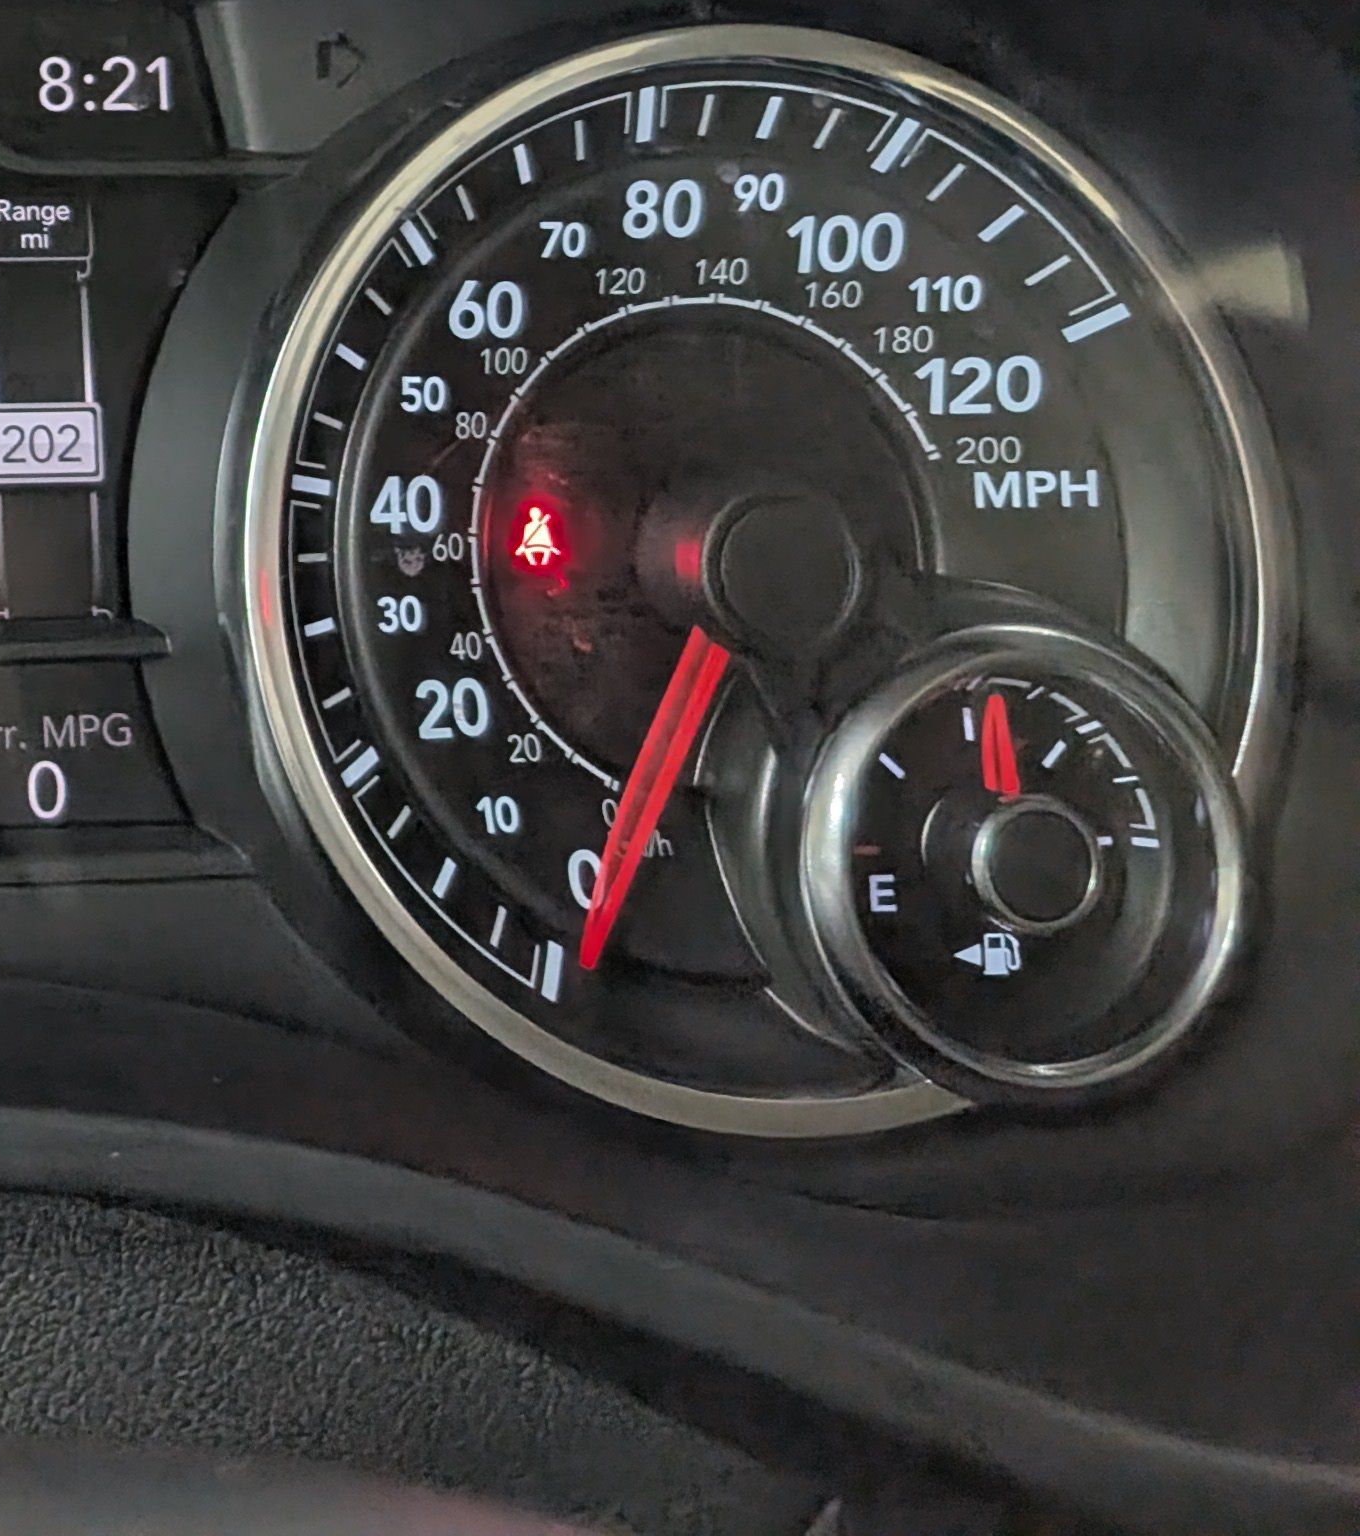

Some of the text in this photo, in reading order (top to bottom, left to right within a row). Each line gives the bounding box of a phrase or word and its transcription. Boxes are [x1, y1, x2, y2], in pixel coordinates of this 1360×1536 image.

[39, 55, 169, 112] 8:21
[622, 178, 703, 239] 80
[733, 172, 785, 212] 90
[20, 226, 50, 249] mi
[539, 221, 587, 259] 70
[786, 212, 905, 274] 100
[595, 267, 646, 295] 120
[695, 257, 749, 286] 140
[448, 279, 524, 340] 60
[805, 280, 863, 309] 160
[908, 274, 983, 313] 110
[873, 325, 934, 354] 180
[480, 346, 528, 375] 100
[400, 375, 447, 413] 50
[913, 355, 1043, 418] 120
[2, 423, 83, 464] 202
[455, 411, 488, 440] 80
[956, 435, 1022, 465] 200
[369, 474, 442, 535] 40
[973, 469, 1099, 509] MPH
[432, 532, 464, 562] 60
[377, 595, 423, 633] 30
[449, 631, 482, 661] 40
[415, 677, 490, 740] 20
[42, 712, 132, 748] MPG
[507, 733, 542, 763] 20
[27, 760, 67, 819] 0
[475, 795, 520, 835] 10
[567, 848, 607, 910] 0
[868, 874, 898, 913] E
